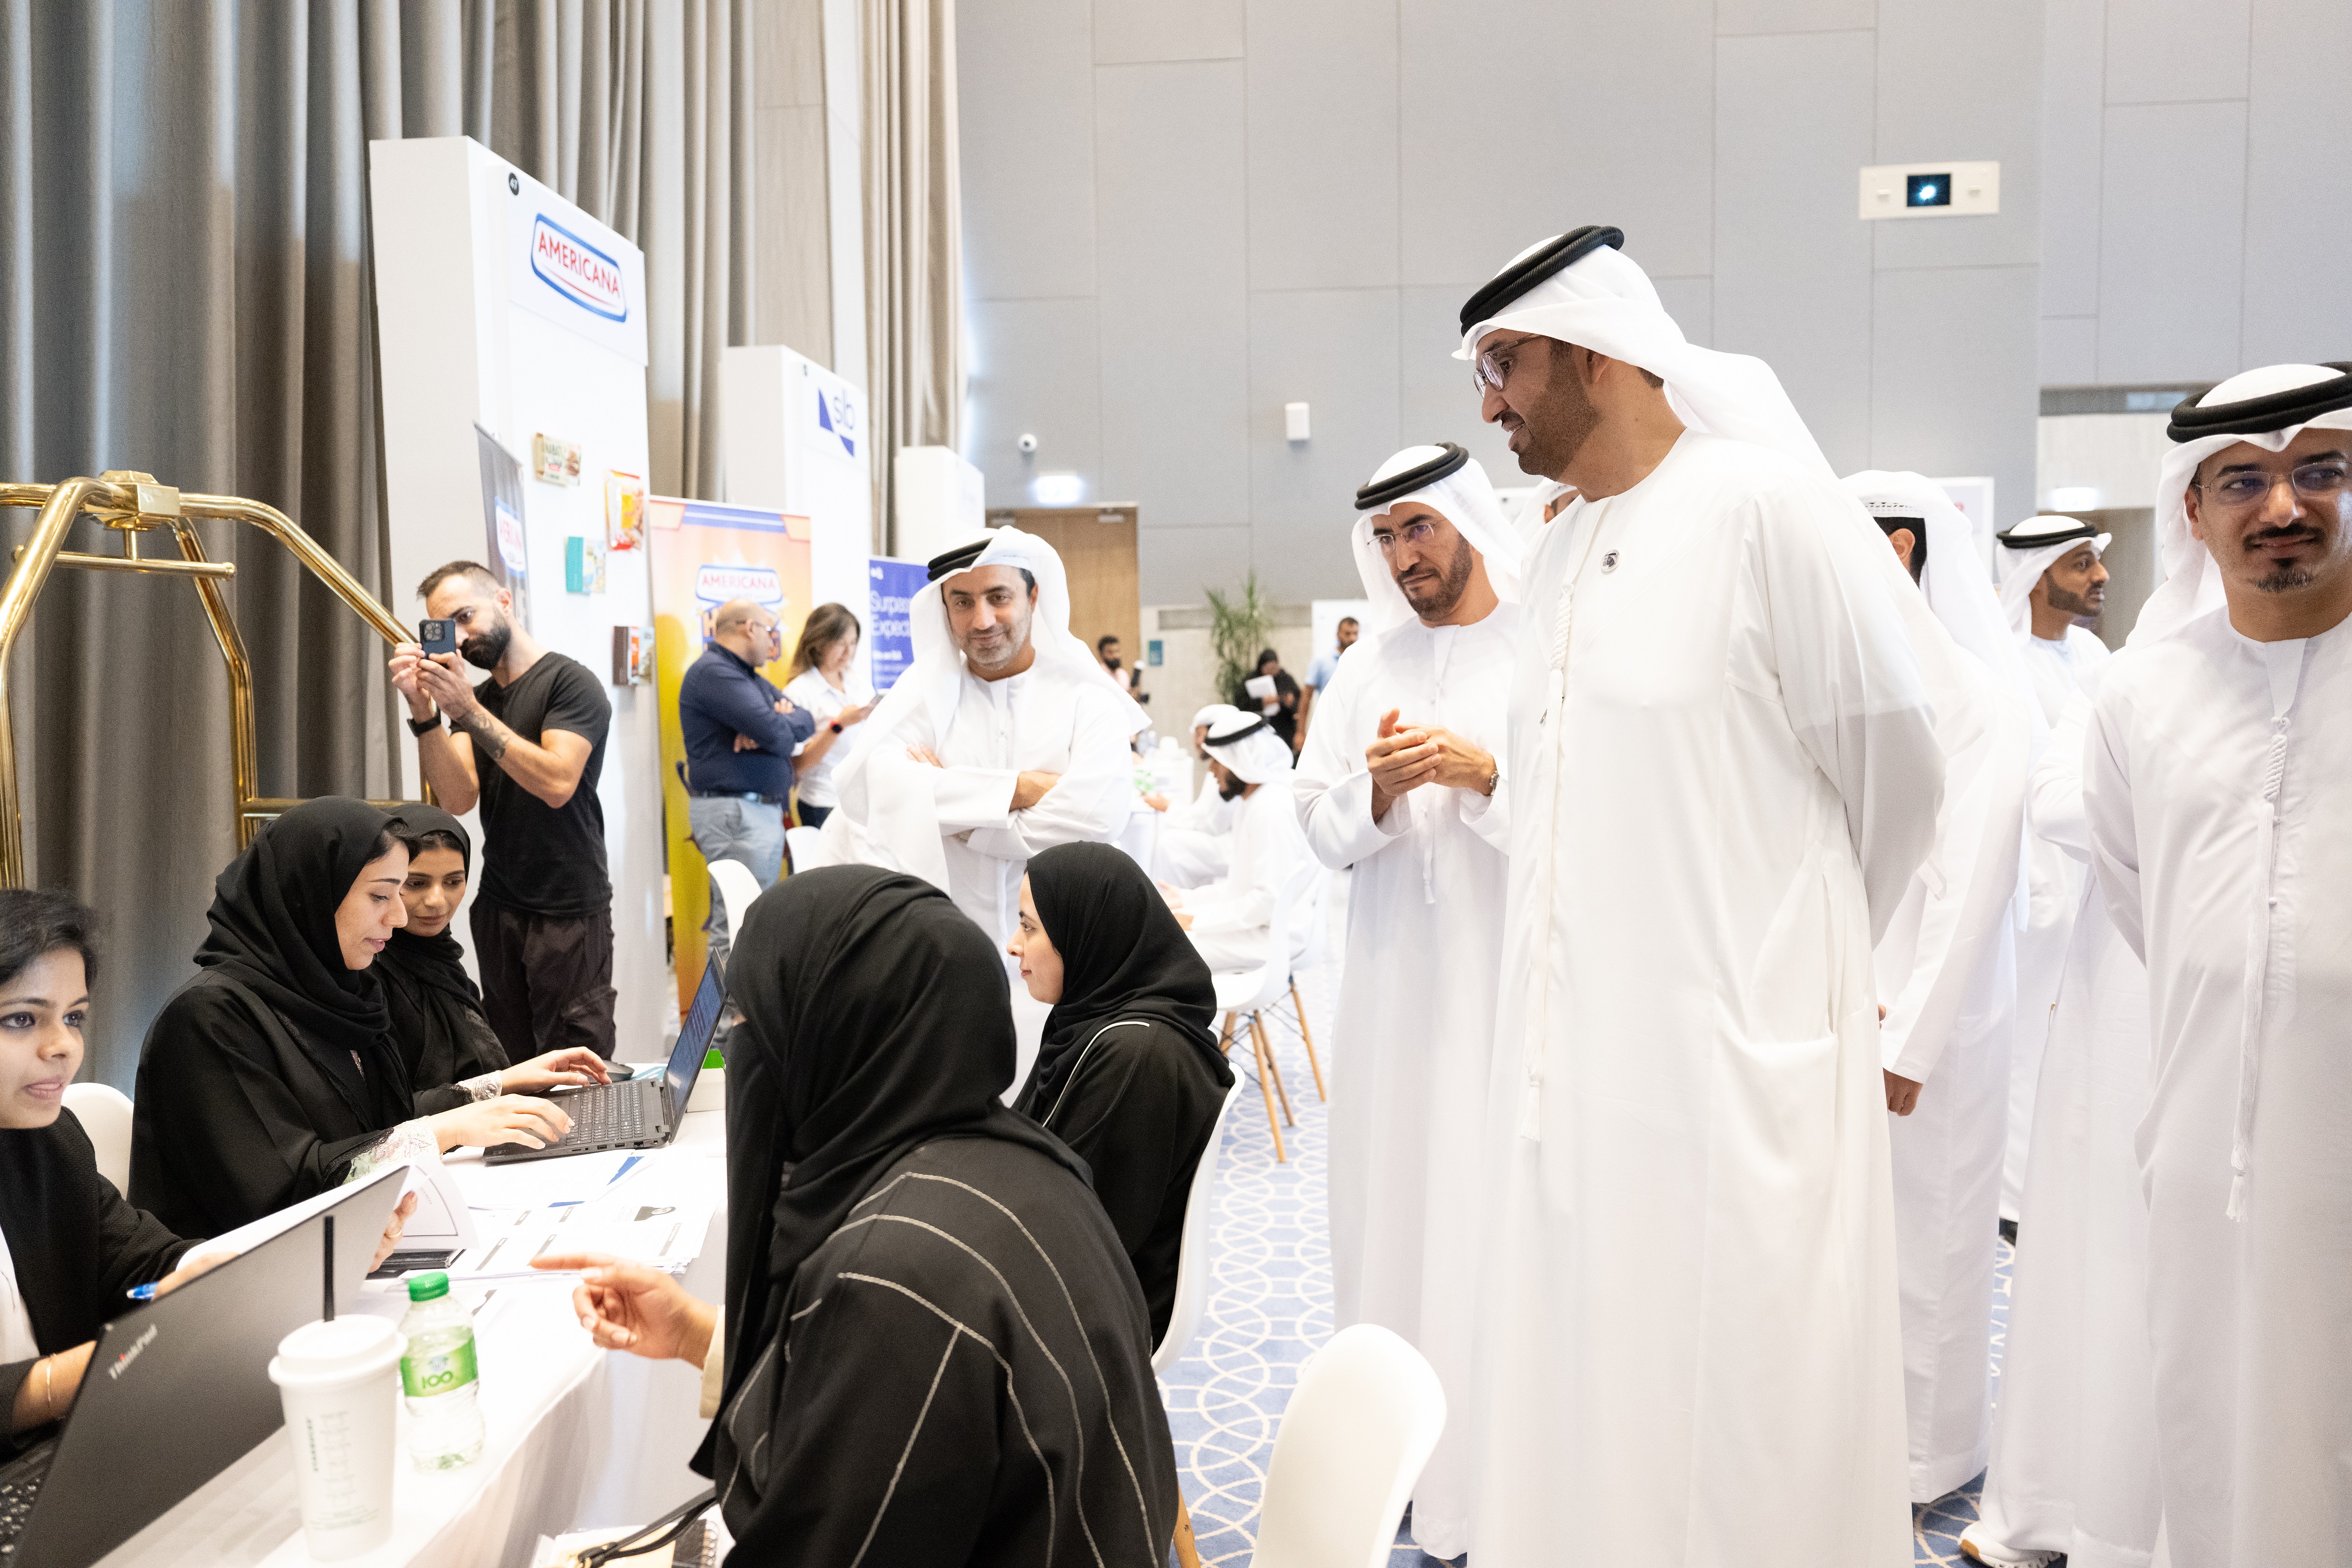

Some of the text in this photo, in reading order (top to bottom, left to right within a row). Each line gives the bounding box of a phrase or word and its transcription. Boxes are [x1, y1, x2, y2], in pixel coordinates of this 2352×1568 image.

[538, 230, 620, 298] AMERICANA
[833, 387, 855, 430] slb
[701, 574, 776, 589] AMERICANA
